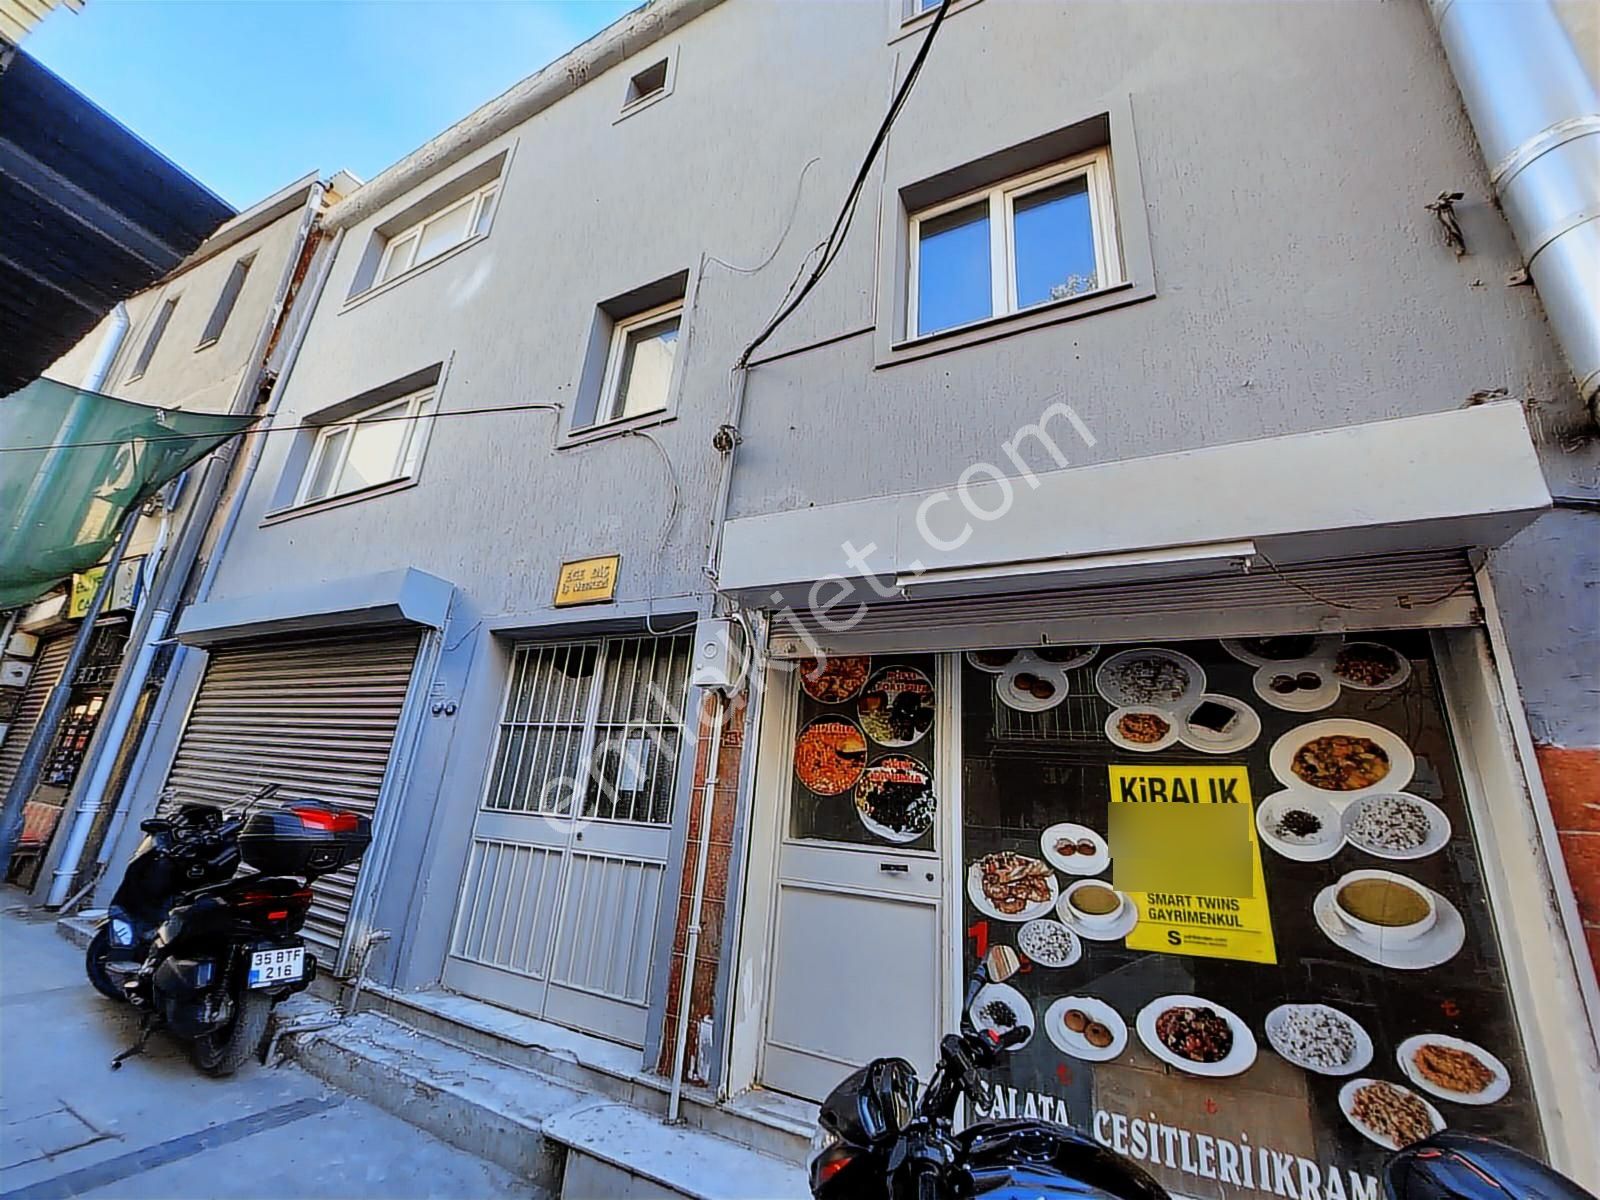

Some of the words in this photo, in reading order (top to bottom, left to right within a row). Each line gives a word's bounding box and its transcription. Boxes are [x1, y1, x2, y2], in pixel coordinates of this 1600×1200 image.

[1147, 892, 1192, 907] SMART
[1196, 896, 1240, 911] TWINS
[1148, 907, 1243, 928] GAYRİMENKUL
[255, 953, 272, 966] 35
[276, 949, 302, 963] BTF
[266, 964, 292, 979] 216
